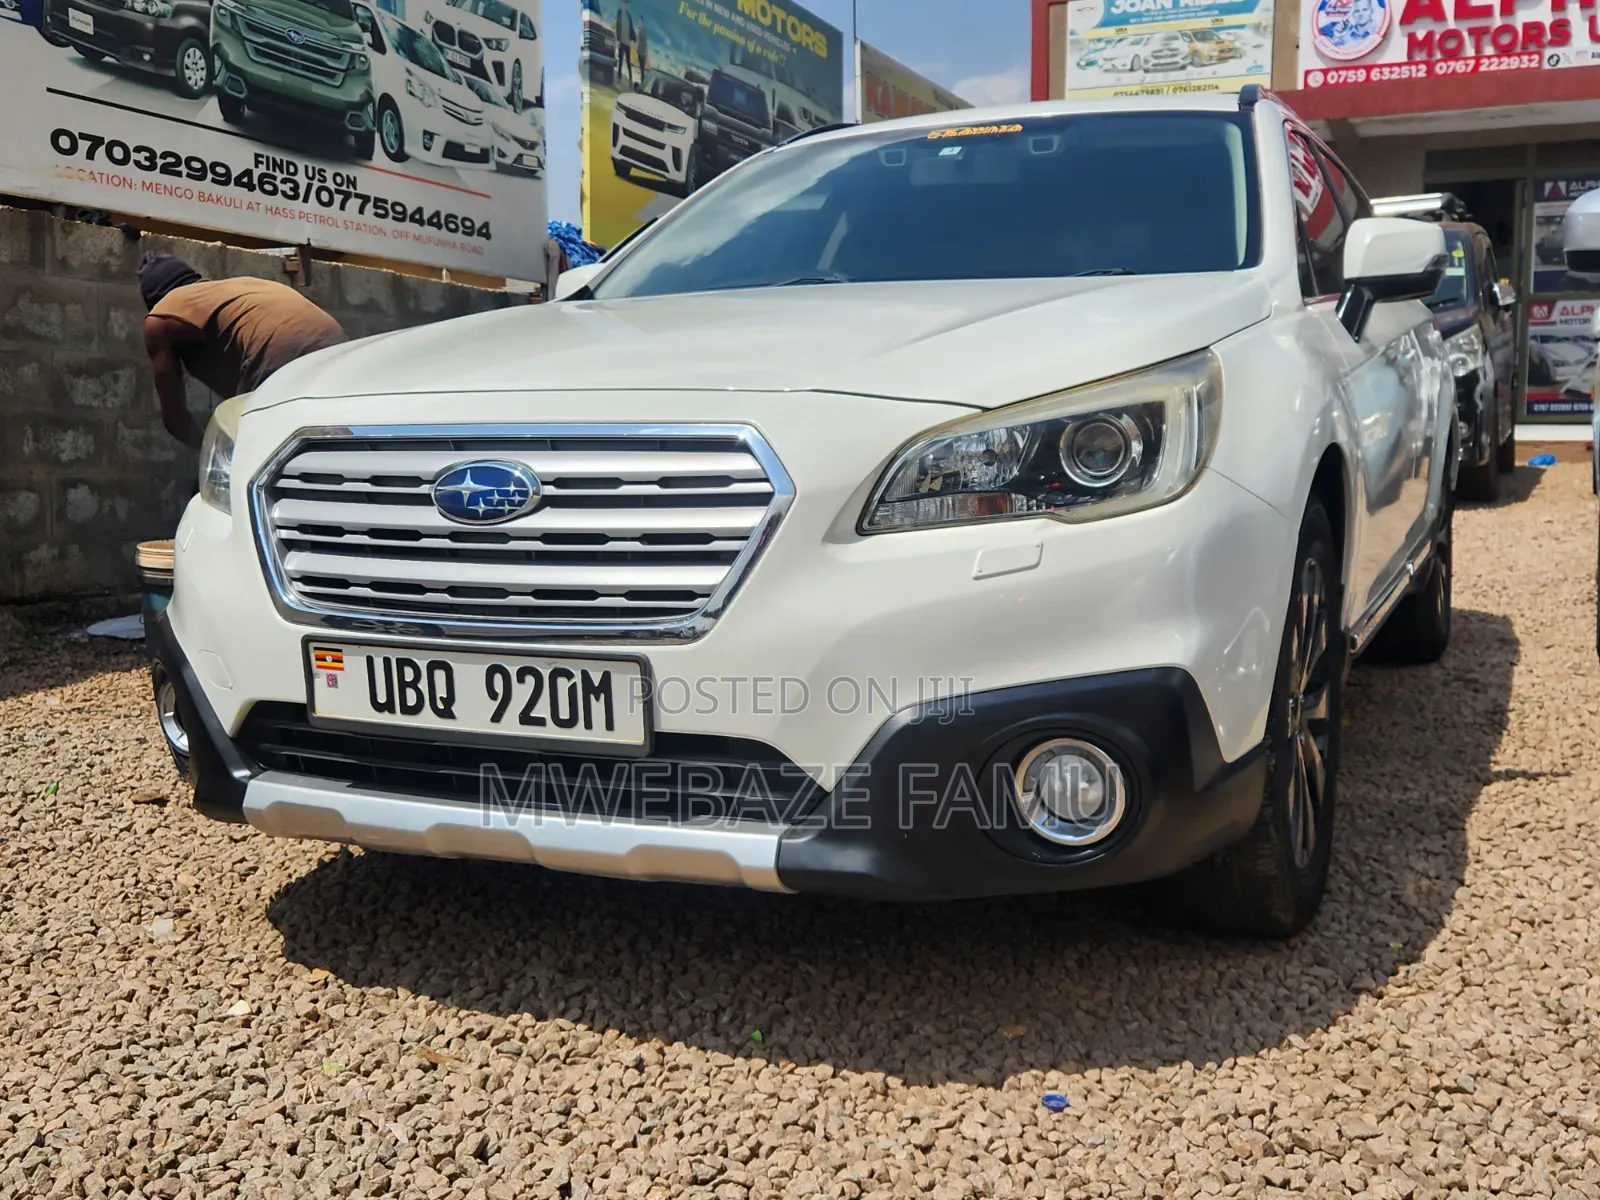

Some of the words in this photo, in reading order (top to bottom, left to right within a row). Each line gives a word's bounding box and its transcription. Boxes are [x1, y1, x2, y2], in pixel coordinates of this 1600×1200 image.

[1407, 18, 1572, 60] MOTORS
[1326, 70, 1367, 84] 0759
[1370, 64, 1427, 81] 632512
[1435, 60, 1476, 75] 0767
[1479, 54, 1540, 72] 222932
[50, 128, 492, 241] 0703299463/0775944694
[254, 152, 298, 177] FIND
[304, 164, 328, 184] US
[332, 171, 358, 191] ON
[55, 164, 138, 190] CATION:
[198, 191, 243, 210] BAKULI
[246, 202, 263, 214] AT
[265, 205, 296, 220] HASS
[298, 210, 341, 229] PETROL
[366, 655, 457, 720] UBQ
[485, 664, 614, 731] 920M
